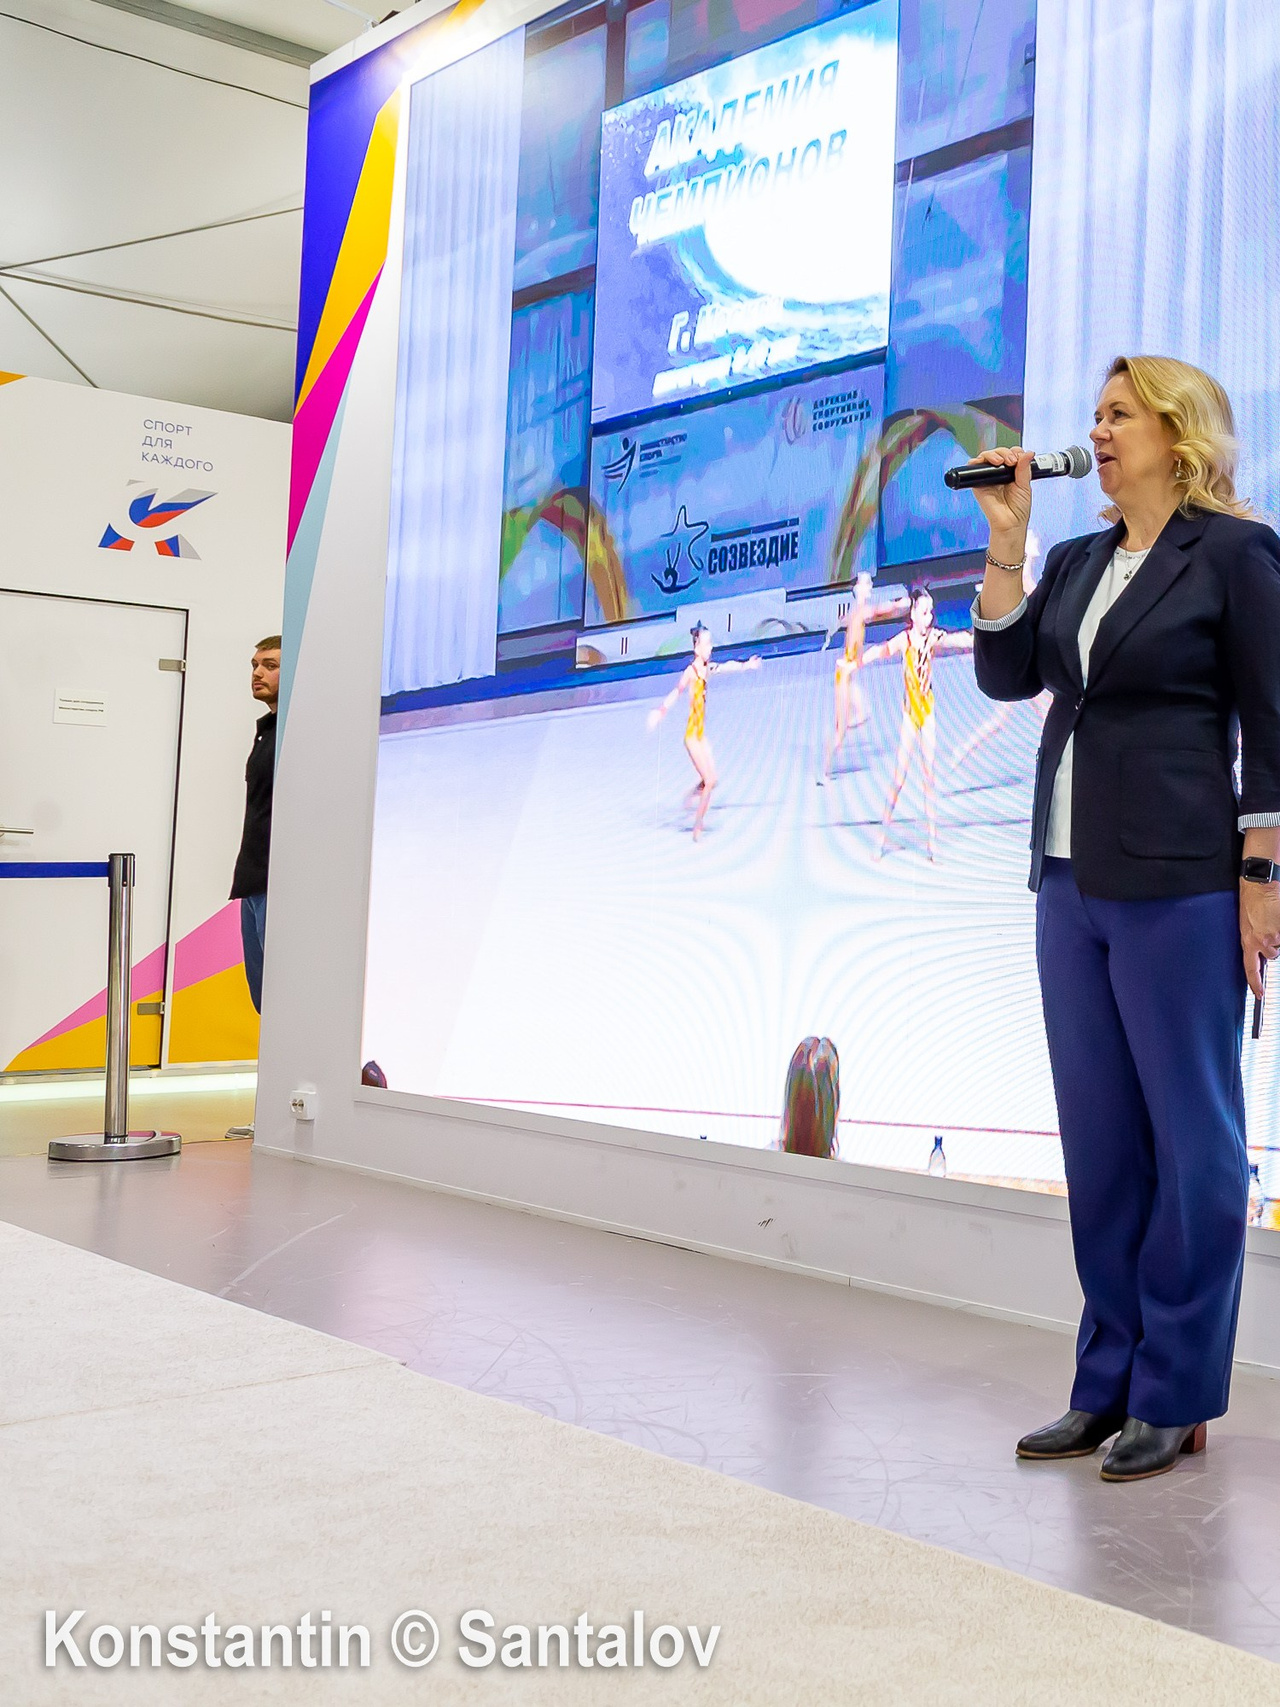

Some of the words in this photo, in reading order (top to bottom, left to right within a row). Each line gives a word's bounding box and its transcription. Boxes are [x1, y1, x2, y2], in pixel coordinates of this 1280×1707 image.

[643, 58, 841, 176] АКАДЕМИЯ
[629, 129, 848, 243] ЧЕМПИОНОВ
[141, 435, 173, 449] ДЛЯ
[143, 418, 193, 436] СПОРТ
[141, 451, 214, 472] КАЖДОГО
[707, 530, 799, 575] СОЗВЕЗДИЕ
